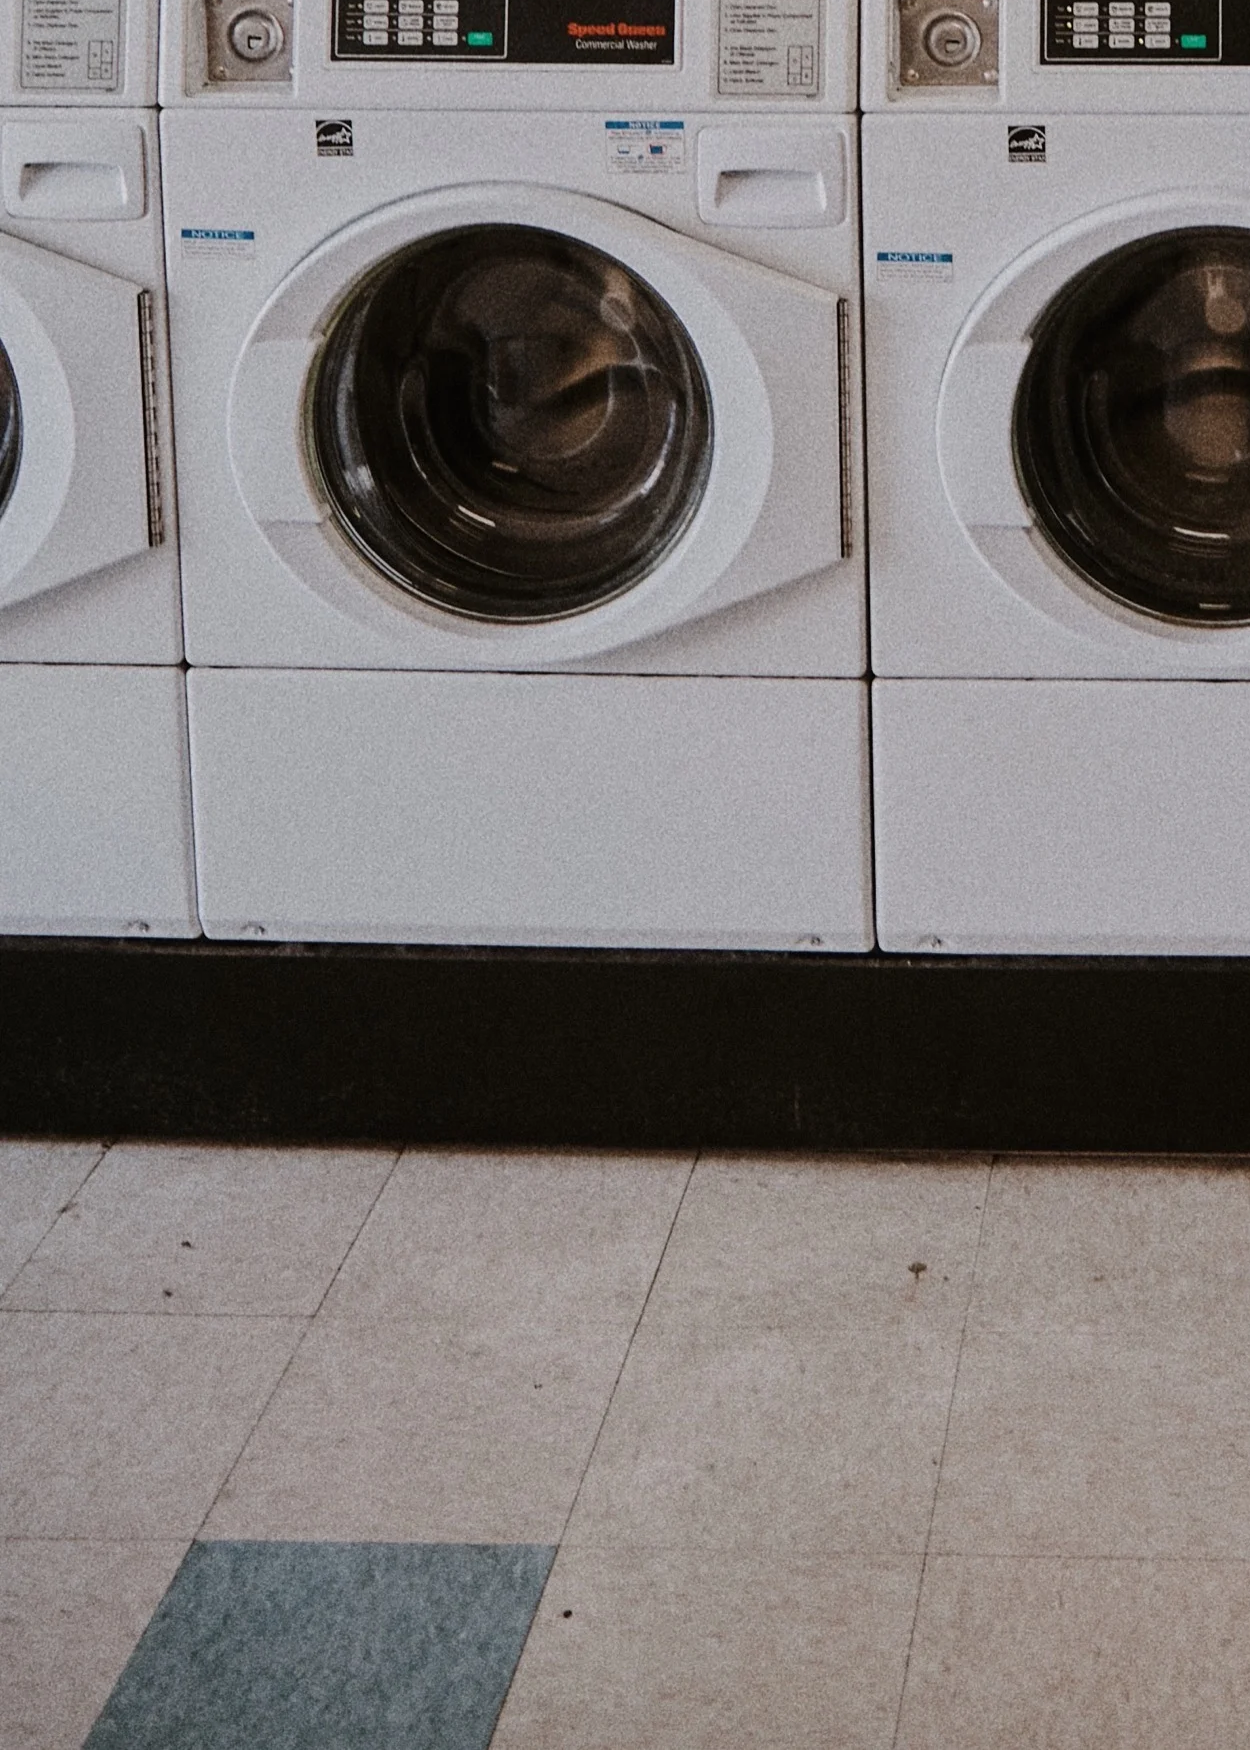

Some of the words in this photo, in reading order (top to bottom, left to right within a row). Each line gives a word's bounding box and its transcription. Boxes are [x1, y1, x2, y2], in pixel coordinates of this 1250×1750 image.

[567, 22, 615, 37] Speed
[617, 22, 666, 36] Queen
[575, 39, 625, 50] Commercial
[626, 39, 657, 50] Washer
[191, 230, 243, 239] NOTICE
[887, 253, 941, 262] NOTICE
